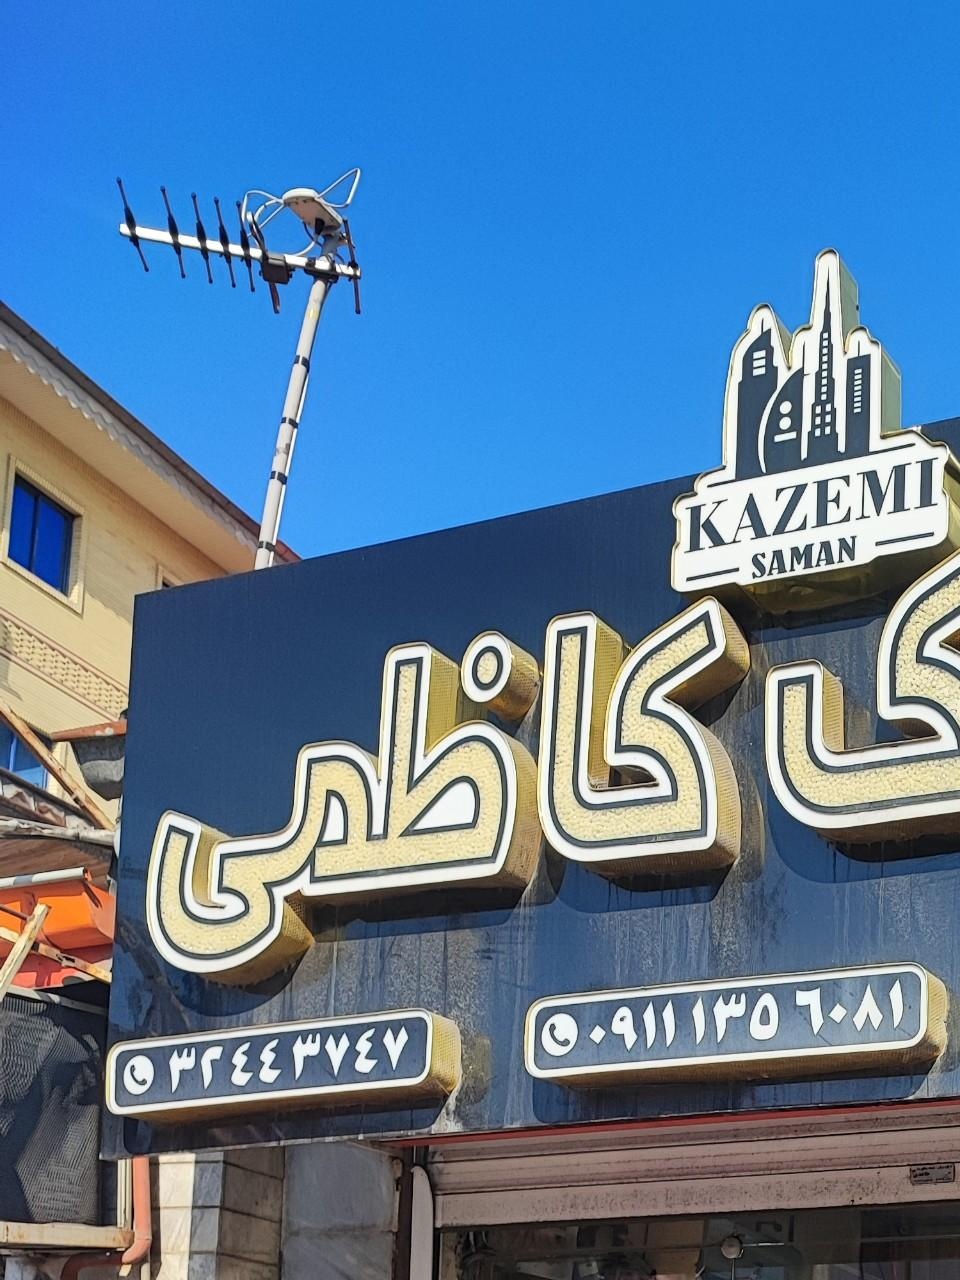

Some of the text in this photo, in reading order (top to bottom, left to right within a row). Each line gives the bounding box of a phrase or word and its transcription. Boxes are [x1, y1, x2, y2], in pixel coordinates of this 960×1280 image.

[684, 457, 939, 554] KAZEMI
[751, 535, 858, 579] SAMAN
[146, 597, 726, 974] کاظمی
